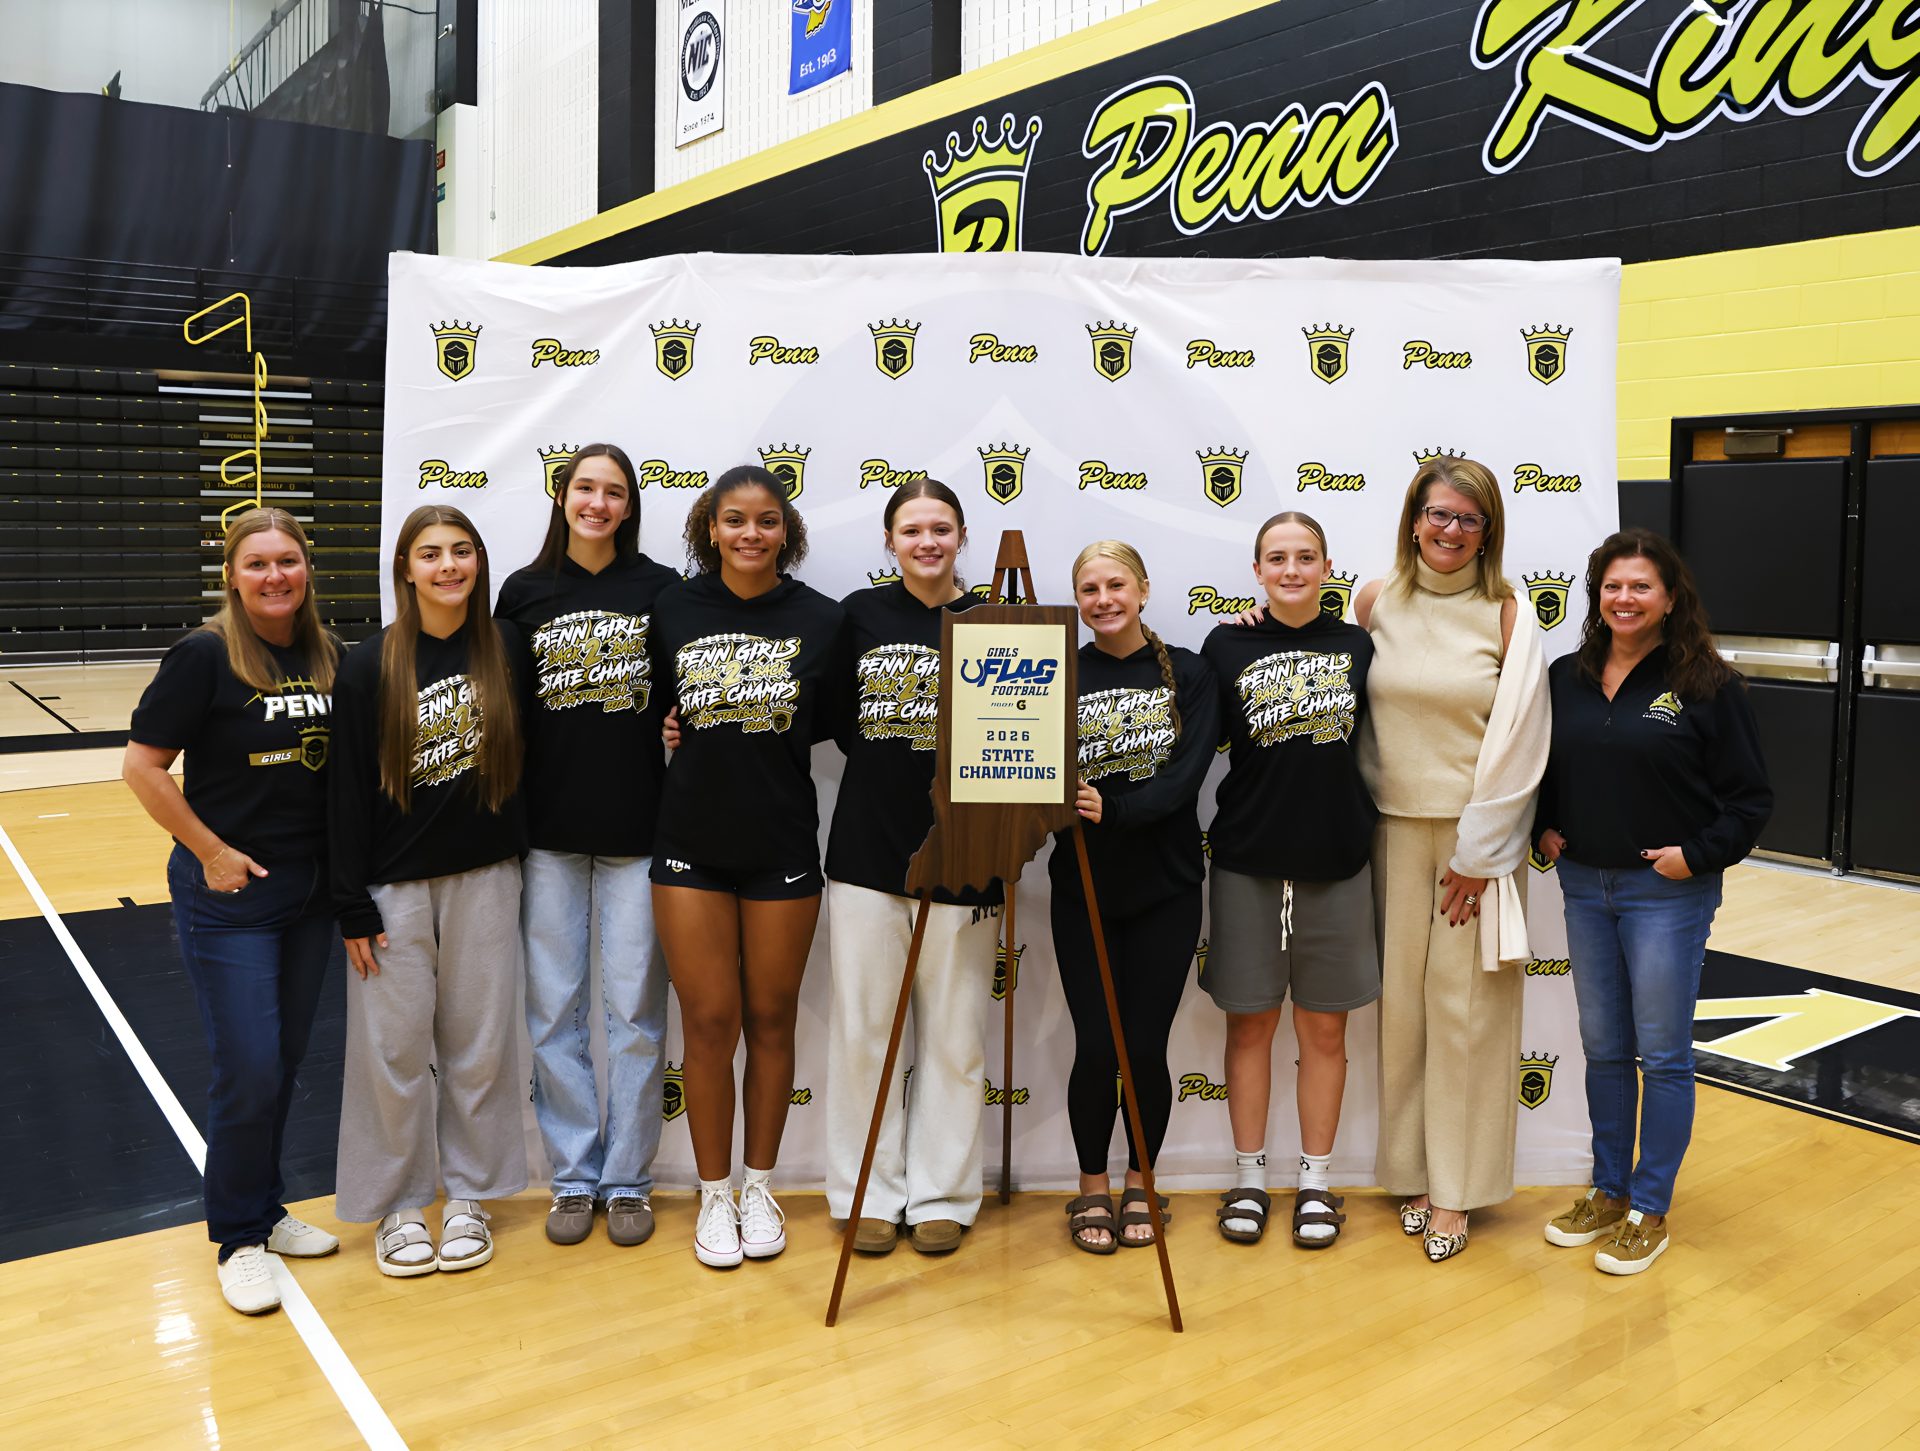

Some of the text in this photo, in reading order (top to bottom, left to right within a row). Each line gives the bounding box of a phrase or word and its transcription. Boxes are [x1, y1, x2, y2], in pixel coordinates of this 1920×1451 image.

[687, 33, 713, 75] NIC
[800, 61, 816, 77] Est.
[1081, 75, 1399, 257] Penn
[532, 339, 600, 368] Penn
[750, 336, 819, 365] Penn
[970, 334, 1038, 363] Penn
[1186, 340, 1255, 369] Penn
[1403, 341, 1472, 369] Penn
[419, 460, 488, 489] Penn
[639, 460, 708, 489] Penn
[1079, 461, 1147, 490] Penn
[1297, 463, 1365, 492] Penn
[1514, 464, 1582, 493] Penn
[534, 615, 650, 657] PENN GIRLS
[581, 637, 604, 668] 2
[676, 639, 799, 674] PENN GIRLS
[858, 652, 911, 678] PENN
[986, 648, 1019, 657] GIRLS
[537, 658, 651, 695] STATE CHAMPS
[720, 660, 743, 688] 2
[977, 659, 1058, 687] FLAG
[1238, 653, 1351, 697] PENN GIRLS
[680, 680, 798, 715] STATE CHAMPS
[897, 673, 920, 703] 2
[991, 686, 1049, 696] FOOTBALL
[1288, 675, 1310, 701] 2
[418, 688, 454, 726] ENN
[858, 700, 939, 722] STATE CHA
[1016, 699, 1027, 711] G
[1078, 688, 1171, 720] ENN GIRLS
[1248, 693, 1356, 735] STATE CHAMPS
[454, 703, 477, 737] 2
[1105, 711, 1127, 740] 2
[986, 731, 1030, 741] 2026
[1078, 727, 1175, 764] ATE CHAMPS
[261, 752, 292, 763] GIRLS
[410, 737, 460, 774] STATE
[982, 749, 1034, 762] STATE
[959, 766, 1056, 780] CHAMPIONS
[666, 858, 691, 870] PENN
[971, 904, 999, 925] NYC
[1525, 958, 1571, 976] enn
[1178, 1073, 1228, 1102] Pen
